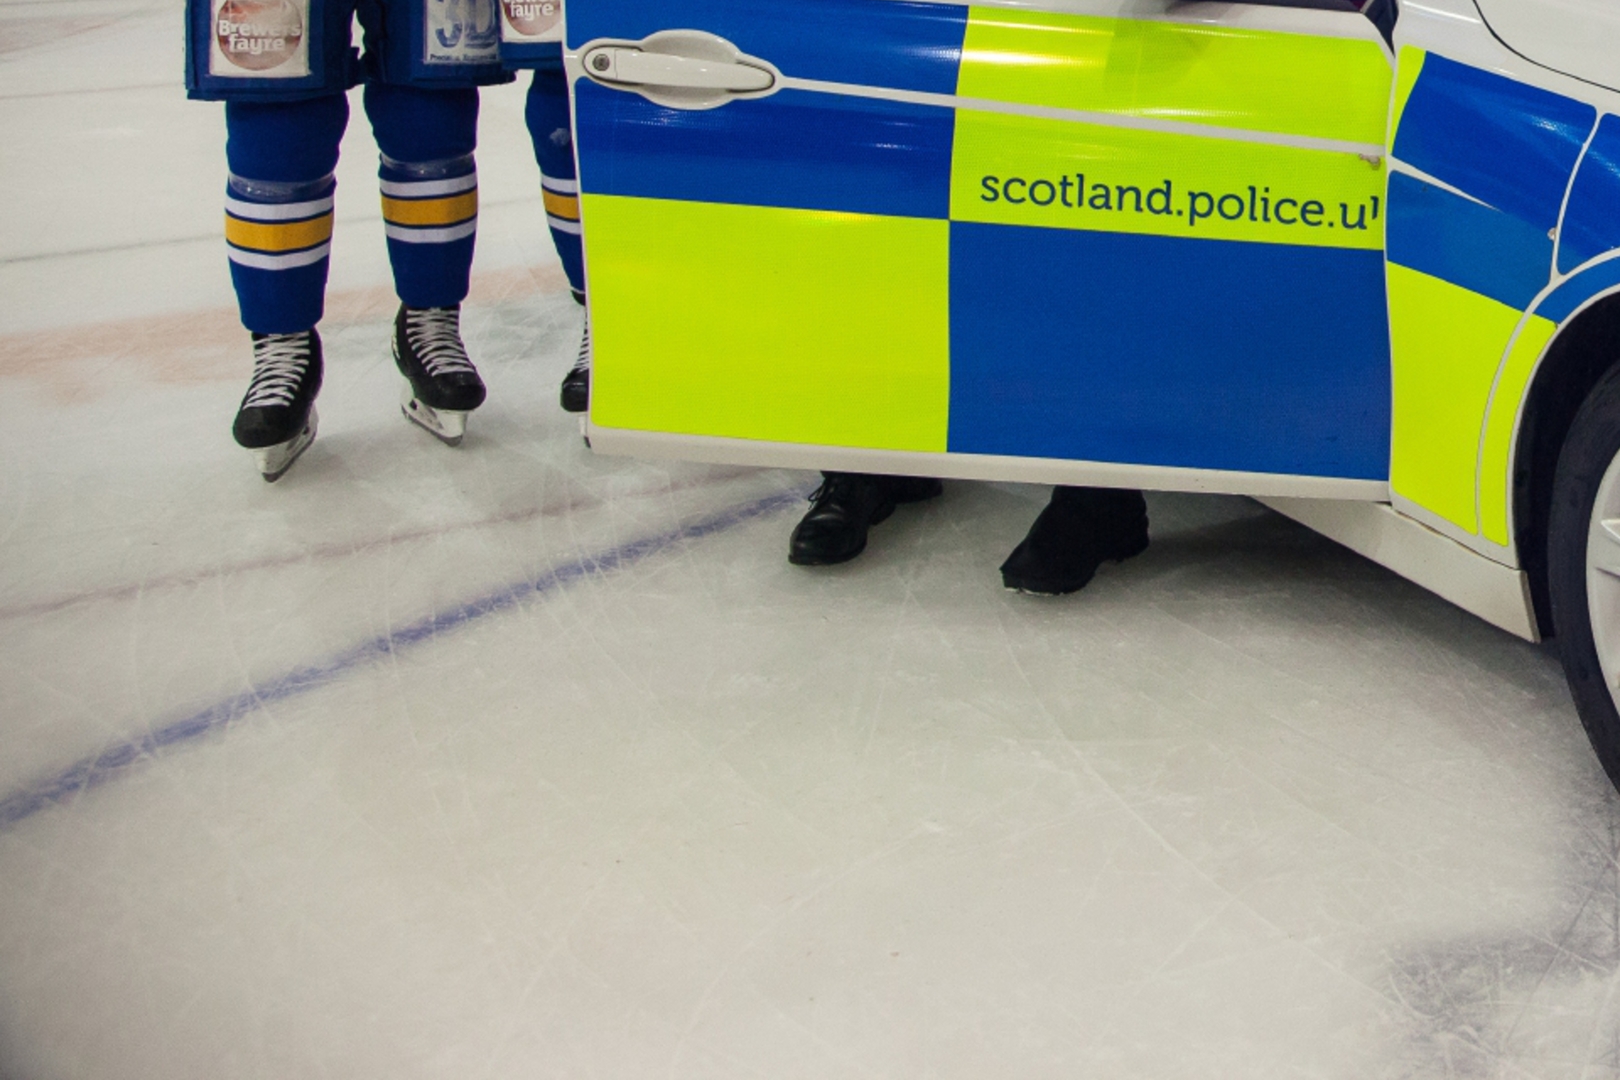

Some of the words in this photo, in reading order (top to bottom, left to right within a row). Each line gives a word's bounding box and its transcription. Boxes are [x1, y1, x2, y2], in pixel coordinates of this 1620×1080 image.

[510, 1, 554, 21] fayre
[218, 19, 301, 37] Brewers
[229, 32, 286, 55] fayre
